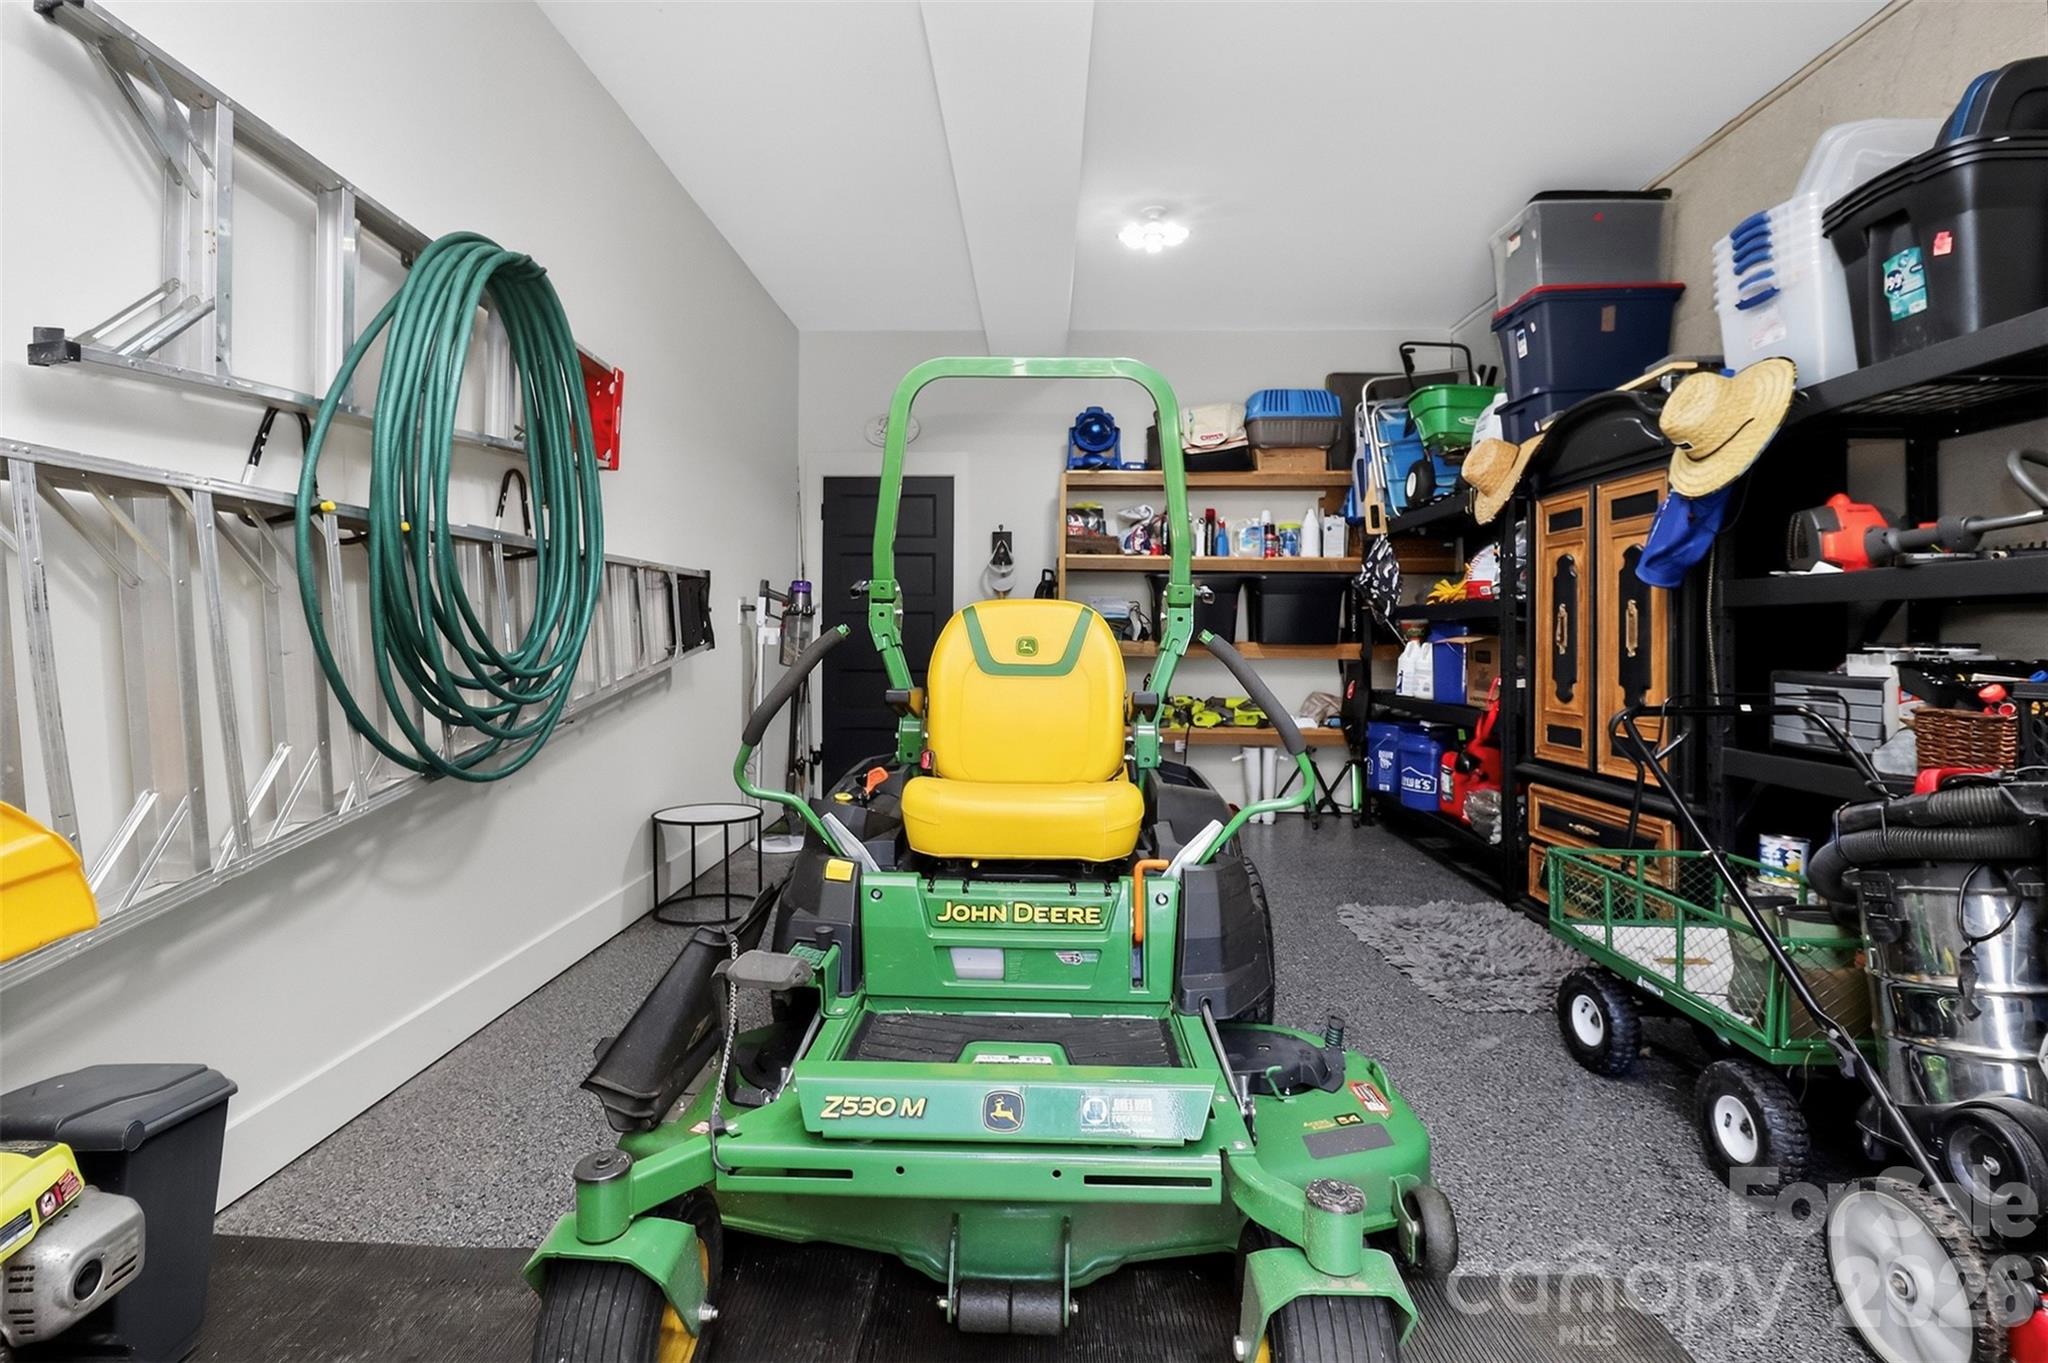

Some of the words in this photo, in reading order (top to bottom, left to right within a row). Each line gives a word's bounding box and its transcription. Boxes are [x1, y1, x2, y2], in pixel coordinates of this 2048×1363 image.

[936, 900, 1008, 923] JOHN
[1012, 900, 1103, 925] DEERE
[820, 1095, 898, 1119] Z530
[899, 1096, 928, 1119] M
